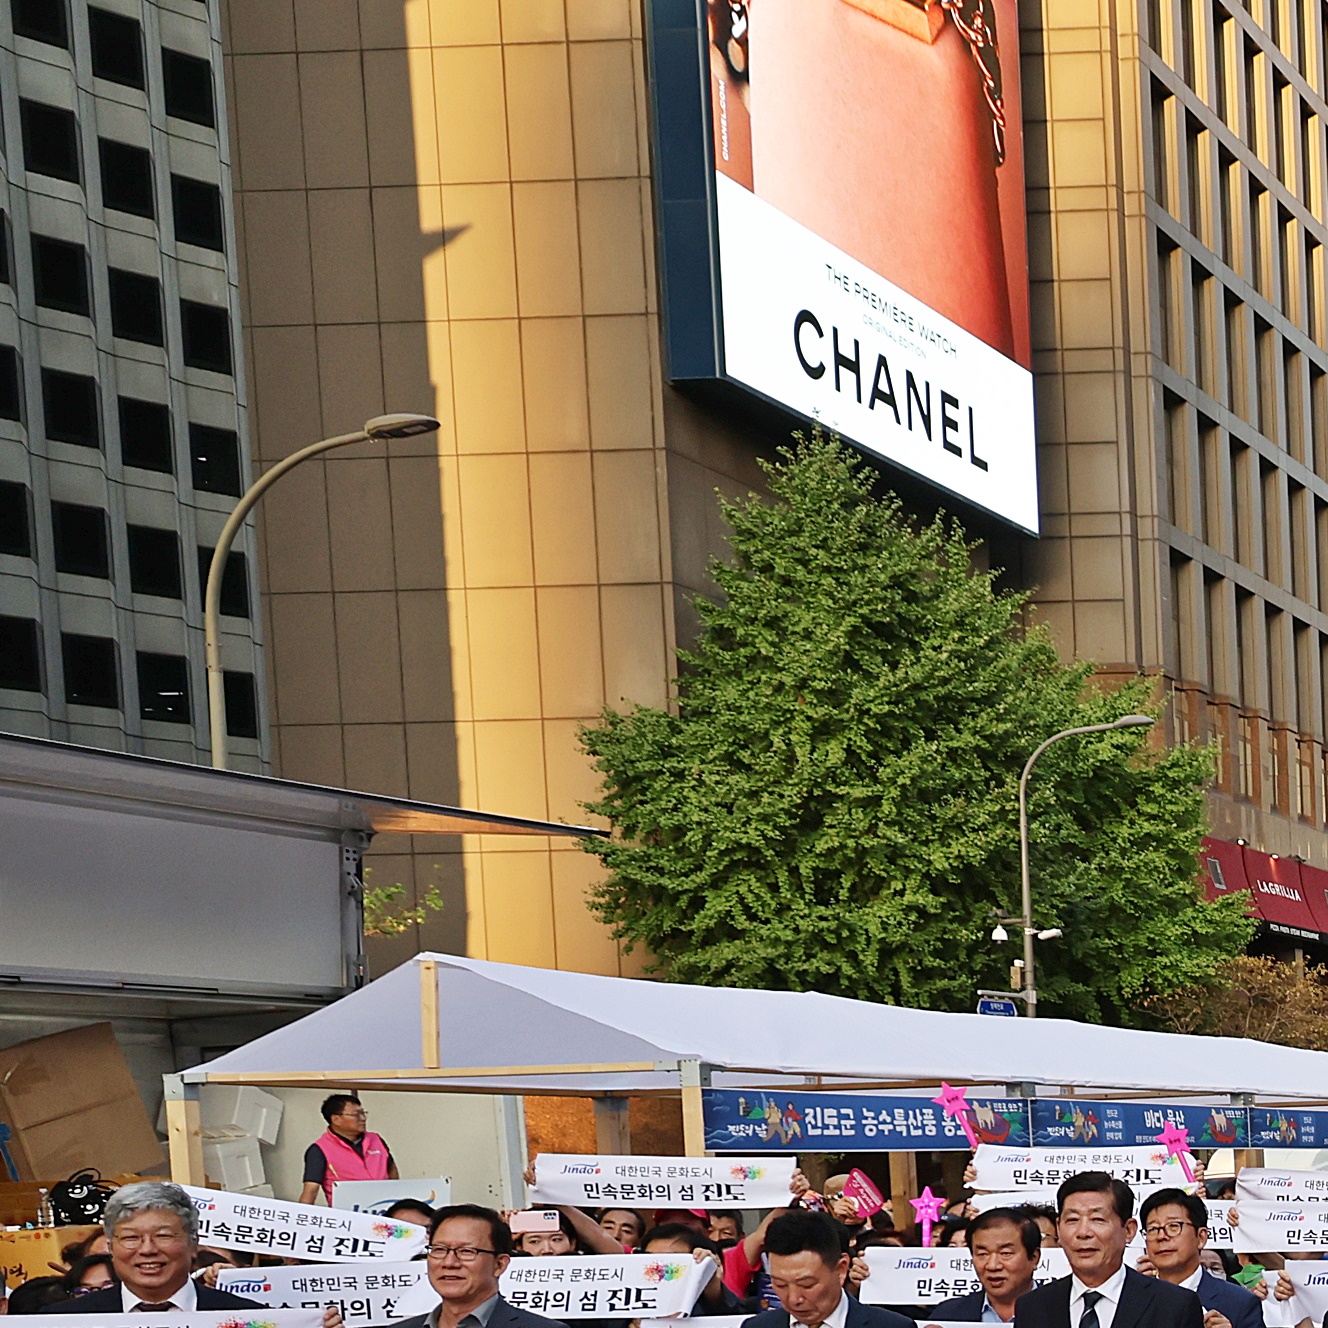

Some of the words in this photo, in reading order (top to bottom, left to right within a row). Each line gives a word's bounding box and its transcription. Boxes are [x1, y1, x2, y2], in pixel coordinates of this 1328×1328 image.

[721, 79, 730, 161] CHANEL.COM
[825, 262, 851, 293] THE
[853, 282, 915, 332] PREMIÈRE
[917, 319, 957, 359] WATCH
[793, 308, 989, 472] CHANEL
[805, 1108, 856, 1136] 진도군
[862, 1109, 936, 1136] 농수특산품
[1144, 1111, 1164, 1128] 바다
[1044, 1154, 1087, 1164] 대한민국
[1091, 1154, 1134, 1165] 문화도시
[615, 1166, 662, 1178] 대한민국
[666, 1166, 713, 1179] 문화도시
[584, 1183, 671, 1200] 민속문화의
[678, 1184, 695, 1201] 섬
[510, 1267, 564, 1283] 대한민국
[570, 1266, 624, 1282] 문화도시
[606, 1287, 658, 1311] 진도
